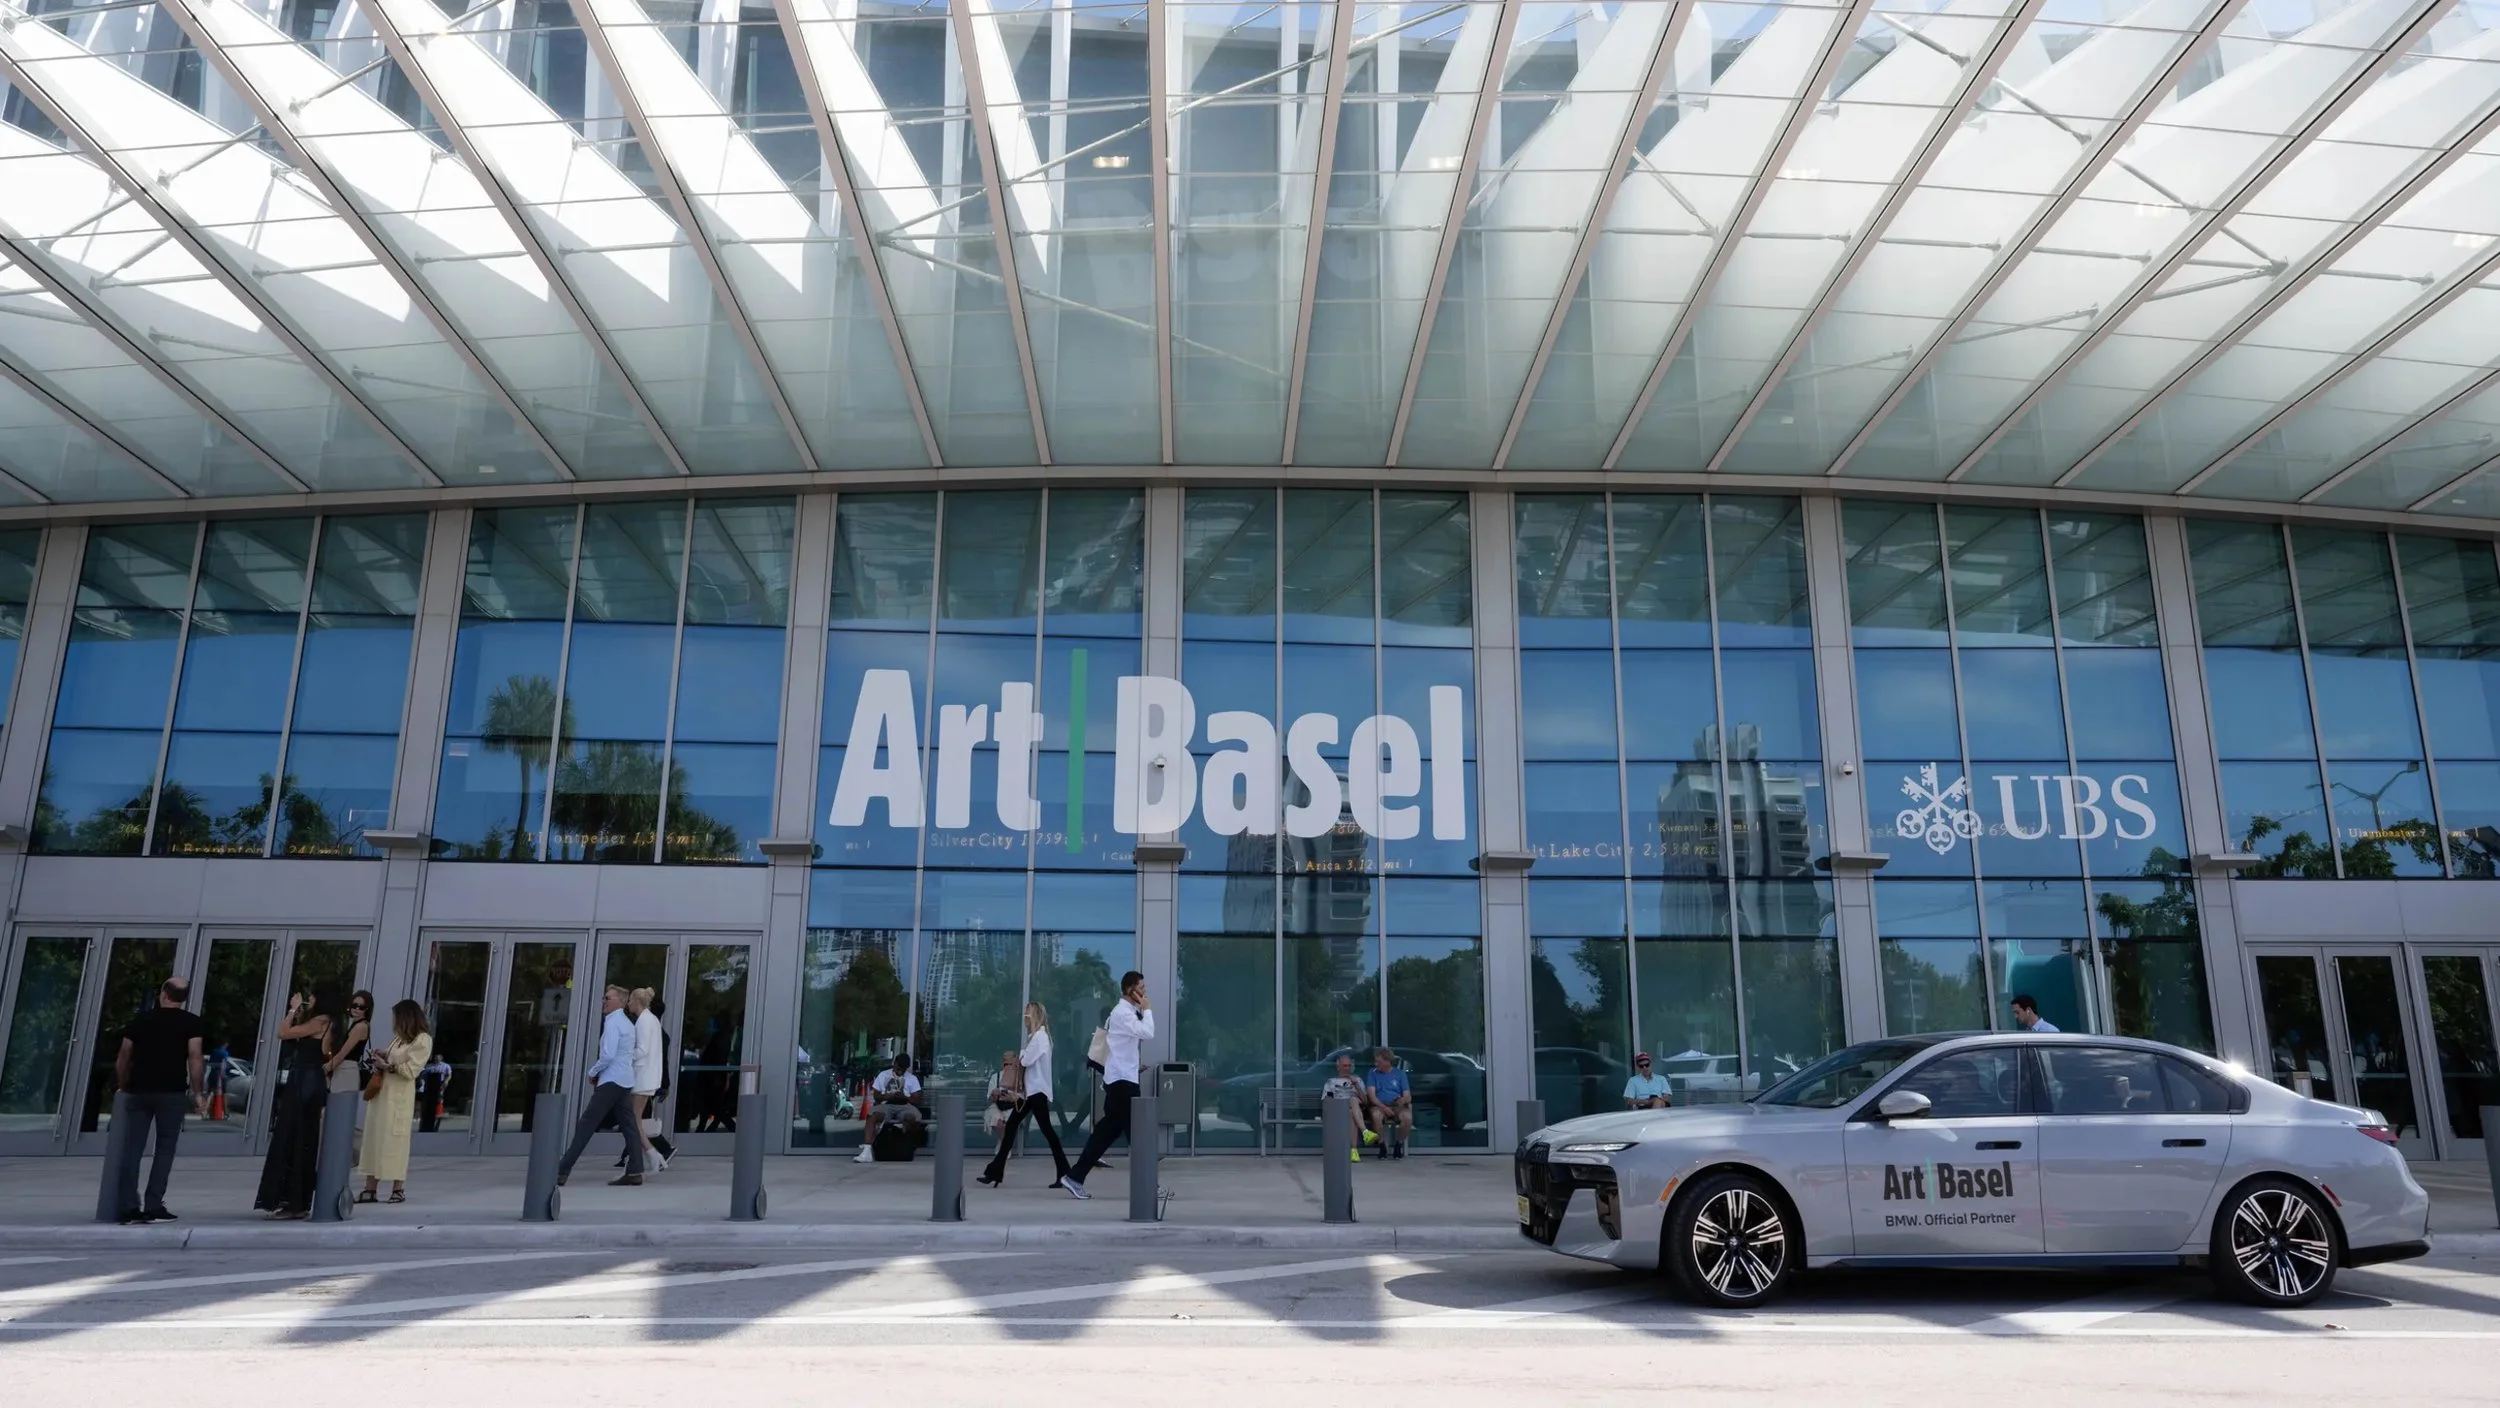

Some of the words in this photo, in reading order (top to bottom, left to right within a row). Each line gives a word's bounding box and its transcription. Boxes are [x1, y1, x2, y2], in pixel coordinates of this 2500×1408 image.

[829, 669, 1043, 831] Art
[1114, 676, 1466, 841] Basel
[1992, 775, 2156, 840] UBS
[632, 832, 675, 846] 1,36
[930, 833, 974, 848] Silver
[978, 832, 1014, 850] City
[1550, 843, 1591, 858] Lake
[1643, 842, 1690, 858] 2,538
[1305, 860, 1341, 871] Arica
[1883, 1164, 1926, 1200] Art
[1937, 1161, 2014, 1199] Basel
[1885, 1215, 1922, 1227] BMW.
[1925, 1213, 1968, 1226] Official
[1970, 1212, 2016, 1224] Partner
